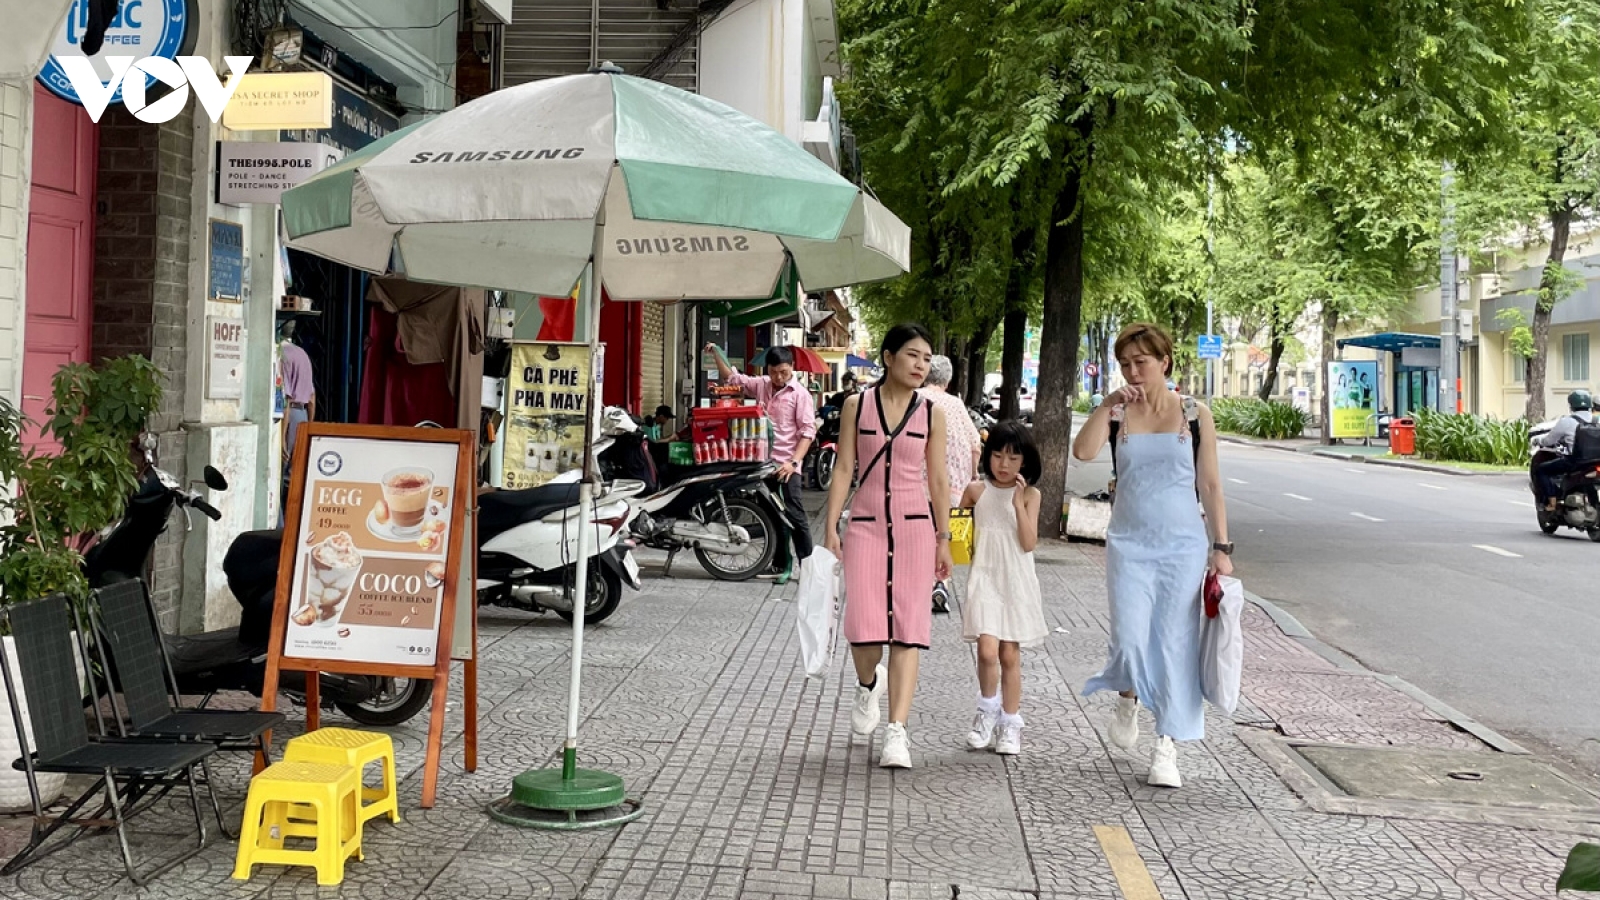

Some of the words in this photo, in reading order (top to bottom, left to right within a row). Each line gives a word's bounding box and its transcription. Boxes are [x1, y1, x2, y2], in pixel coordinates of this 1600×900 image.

[80, 34, 141, 45] FFEE
[251, 91, 289, 100] SECRET
[292, 90, 320, 98] SHOP
[410, 147, 585, 164] SAMSUNG
[214, 322, 242, 342] HOFF
[514, 390, 545, 408] PHA
[318, 486, 363, 507] EGG
[317, 506, 348, 515] COFFEE
[359, 572, 421, 595] COCO
[359, 593, 389, 602] COFFEE
[391, 595, 404, 603] ICE
[406, 596, 433, 604] BLEND
